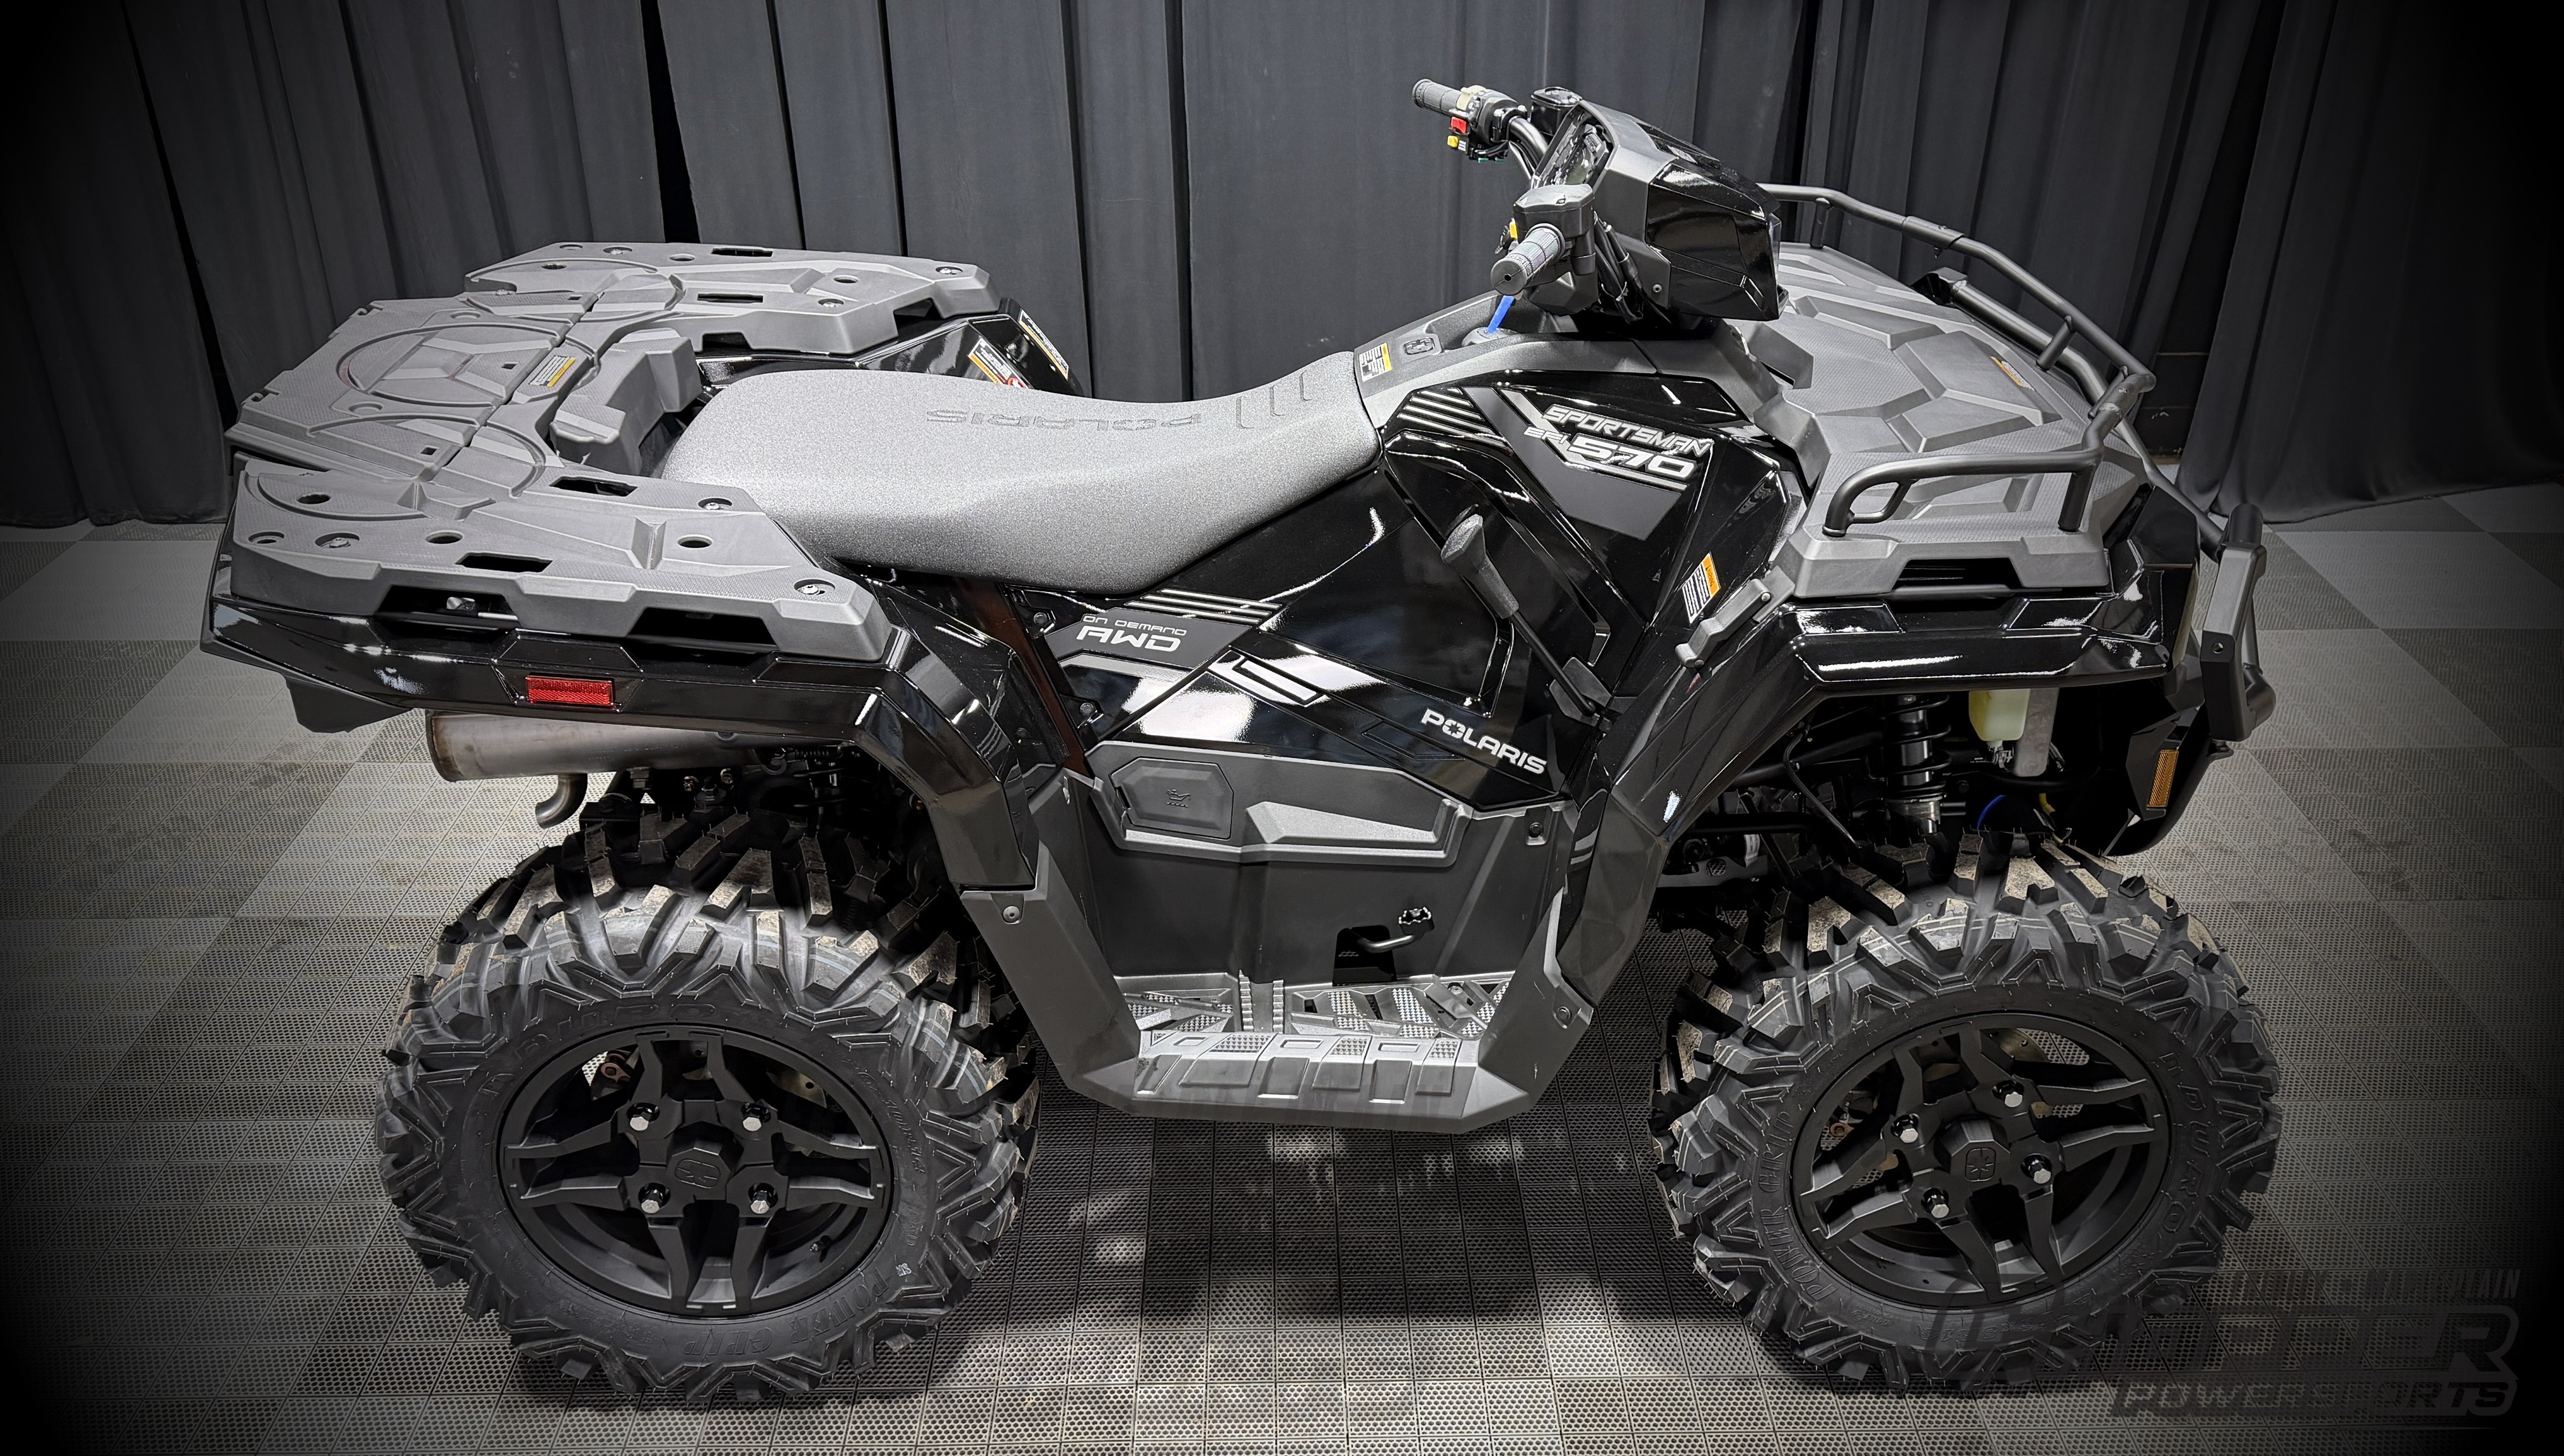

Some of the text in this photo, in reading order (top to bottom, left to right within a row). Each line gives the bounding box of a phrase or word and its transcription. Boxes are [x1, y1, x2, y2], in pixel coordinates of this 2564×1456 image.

[926, 409, 1202, 431] POLARIS
[1524, 426, 1568, 445] EFI
[1543, 404, 1714, 458] SPORTSMAN
[1568, 434, 1698, 478] 570
[1076, 626, 1182, 652] AWD
[1082, 615, 1187, 636] ON DEMAND
[1420, 708, 1547, 774] POLARIS
[1760, 1205, 1838, 1301] POWER
[682, 1267, 890, 1356] POWER GRIP
